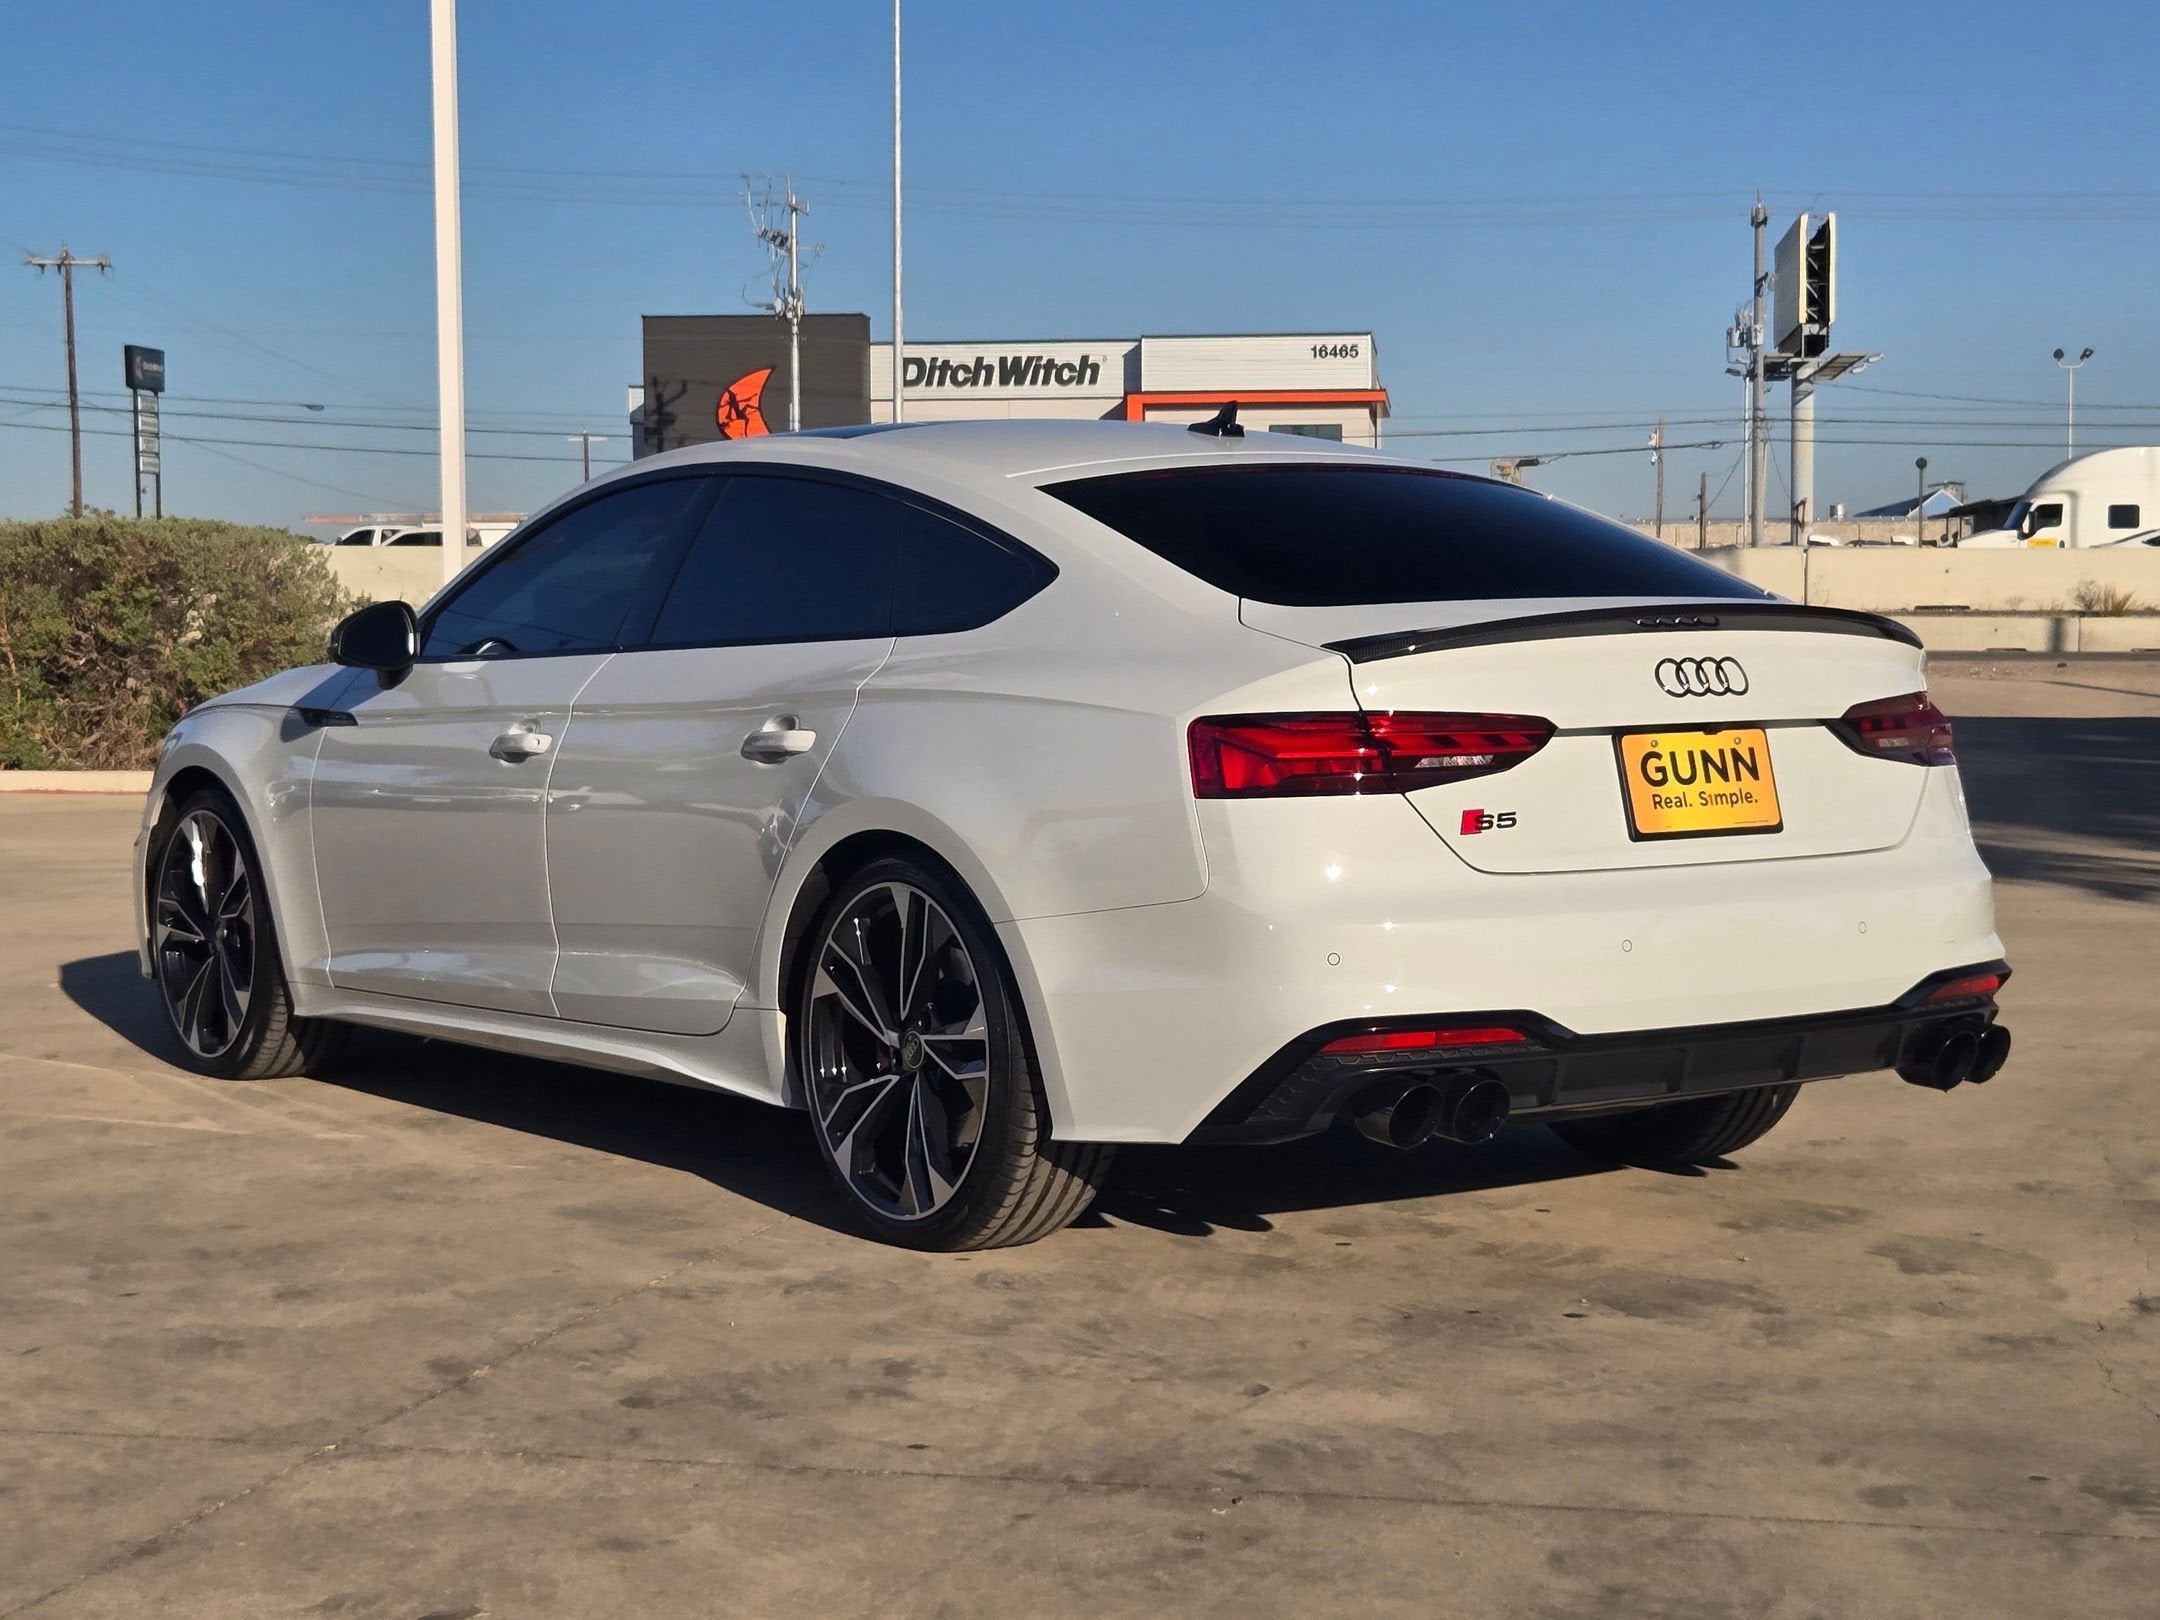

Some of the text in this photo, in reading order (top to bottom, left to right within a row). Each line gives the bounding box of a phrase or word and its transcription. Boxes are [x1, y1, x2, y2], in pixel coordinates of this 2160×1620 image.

[1310, 343, 1360, 360] 16465
[903, 355, 1100, 387] Ditch Witch
[1640, 747, 1760, 787] GUNN
[1652, 791, 1693, 810] Real.
[1474, 811, 1517, 831] S5
